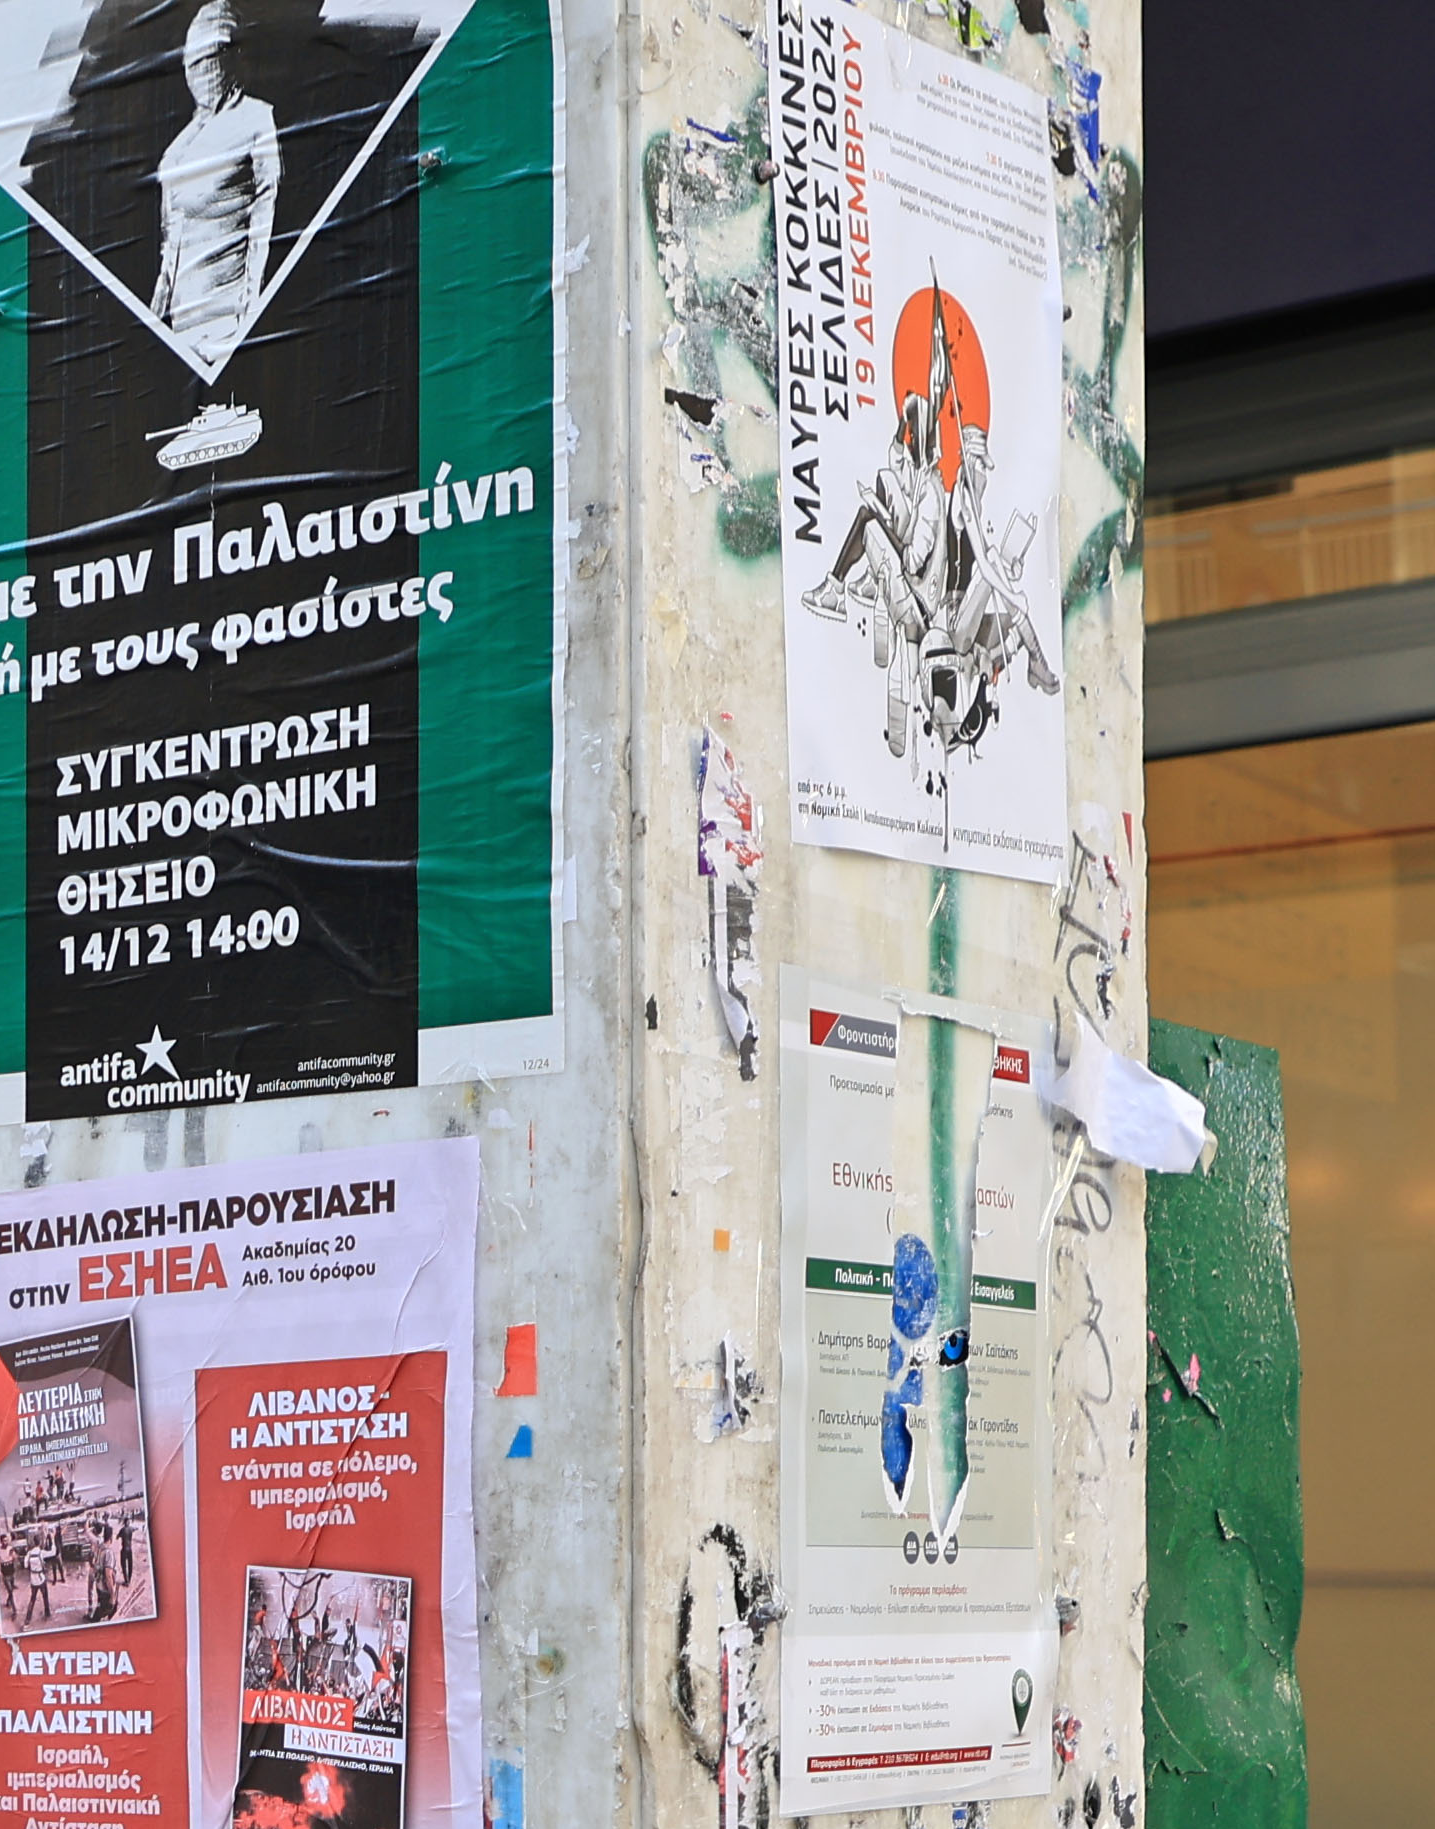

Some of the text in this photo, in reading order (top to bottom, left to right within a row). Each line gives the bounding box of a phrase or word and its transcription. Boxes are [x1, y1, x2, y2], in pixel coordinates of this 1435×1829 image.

[809, 15, 850, 423] ΣΕΛΙΔΕΣ 2024
[841, 25, 877, 409] 19 ΔΕΚΕΜΒΡΙΟΥ
[776, 0, 823, 545] ΜΑΥΡΕΣ ΚΟΚΚΙΝΕΣ
[54, 547, 153, 610] την
[173, 460, 534, 585] Παλαιστίνη
[30, 648, 81, 702] με
[91, 618, 199, 676] τους
[210, 570, 455, 664] φασίστες
[55, 703, 371, 797] ΣΥΓΚΕΝΤΡΩΣΗ
[56, 765, 378, 855] ΜΙΚΡΟΦΩΝΙΚΗ
[57, 855, 216, 916] ΘΗΣΕΙΟ
[58, 904, 301, 976] 14/12 14:00
[60, 1051, 138, 1089] antifa
[297, 1050, 397, 1075] antifacommunity.gr
[107, 1069, 251, 1109] community
[256, 1069, 397, 1095] antifacommunity@yahoo.gr
[242, 1234, 356, 1262] Ακαδημίας 20
[8, 1242, 229, 1311] στην ΕΣΗΕΑ
[242, 1268, 274, 1288] Αιθ.
[278, 1267, 305, 1284] 1ου
[818, 1331, 864, 1350] Δημήτρης
[18, 1381, 83, 1415] ΛΕΥΤΕΡΙΑ
[248, 1384, 376, 1417] ΛΙΒΑΝΟΣ
[18, 1402, 106, 1440] ΠΑΛΑΙΣΤΙΝΗ
[230, 1411, 408, 1449] Η ΑΝΤΙΣΤΑΣΗ
[220, 1457, 304, 1482] ενάντια
[308, 1460, 334, 1479] σε
[249, 1475, 389, 1510] ιμπεριαλισμό,
[285, 1503, 357, 1534] Ισραήλ
[9, 1651, 135, 1676] ΛΕΥΤΕΡΙΑ
[42, 1684, 102, 1705] ΣΤΗΝ
[250, 1694, 347, 1727] ΛΙΒΑΝΟΣ
[36, 1744, 110, 1769] Ισραήλ,
[306, 1731, 395, 1760] ΑΝΤΙΣΤΑΣΗ
[7, 1768, 142, 1794] ιμπεριαλισμός
[22, 1792, 162, 1816] Παλαιστινιακή
